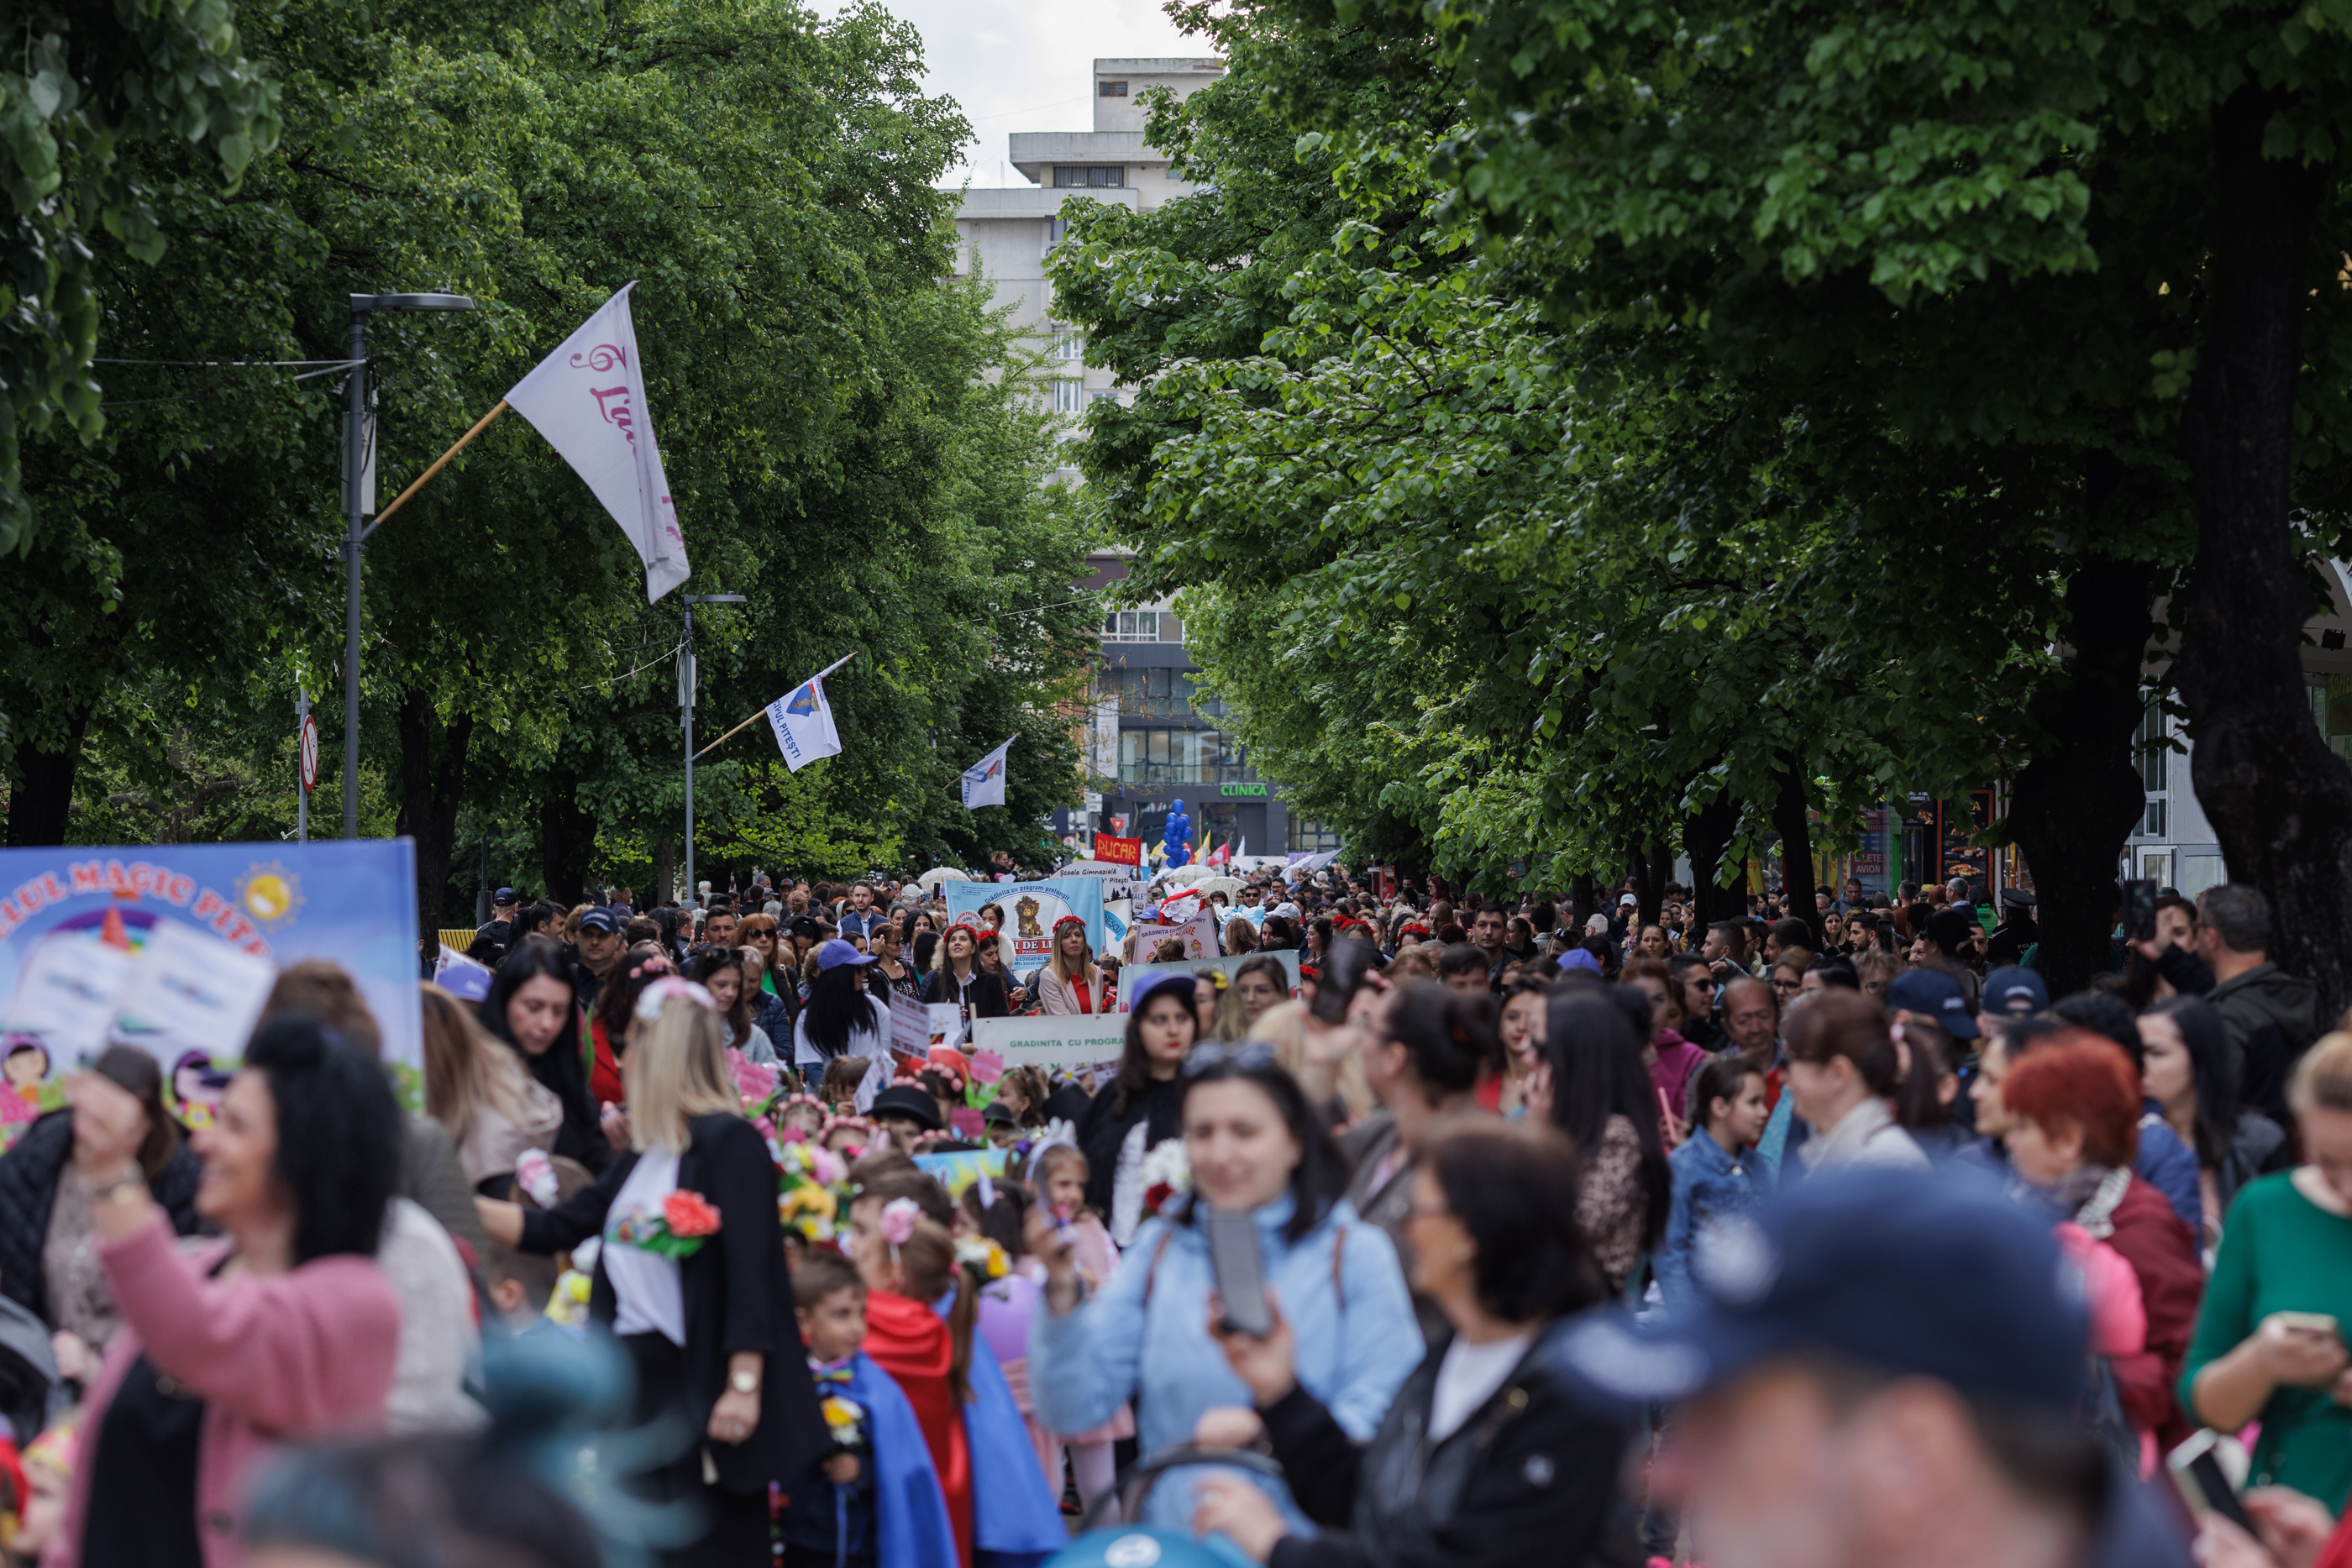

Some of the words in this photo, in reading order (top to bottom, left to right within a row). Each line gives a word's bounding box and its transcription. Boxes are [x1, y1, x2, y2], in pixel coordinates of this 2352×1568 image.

[779, 722, 801, 759] PITEȘTI
[1096, 839, 1136, 860] RUCAR
[1856, 865, 1881, 873] AVION
[70, 860, 194, 905] MAGIC
[1045, 886, 1070, 901] prelungit
[1022, 940, 1039, 950] DE
[1010, 1040, 1063, 1048] GRADINITA
[1084, 1037, 1126, 1046] PROGRA
